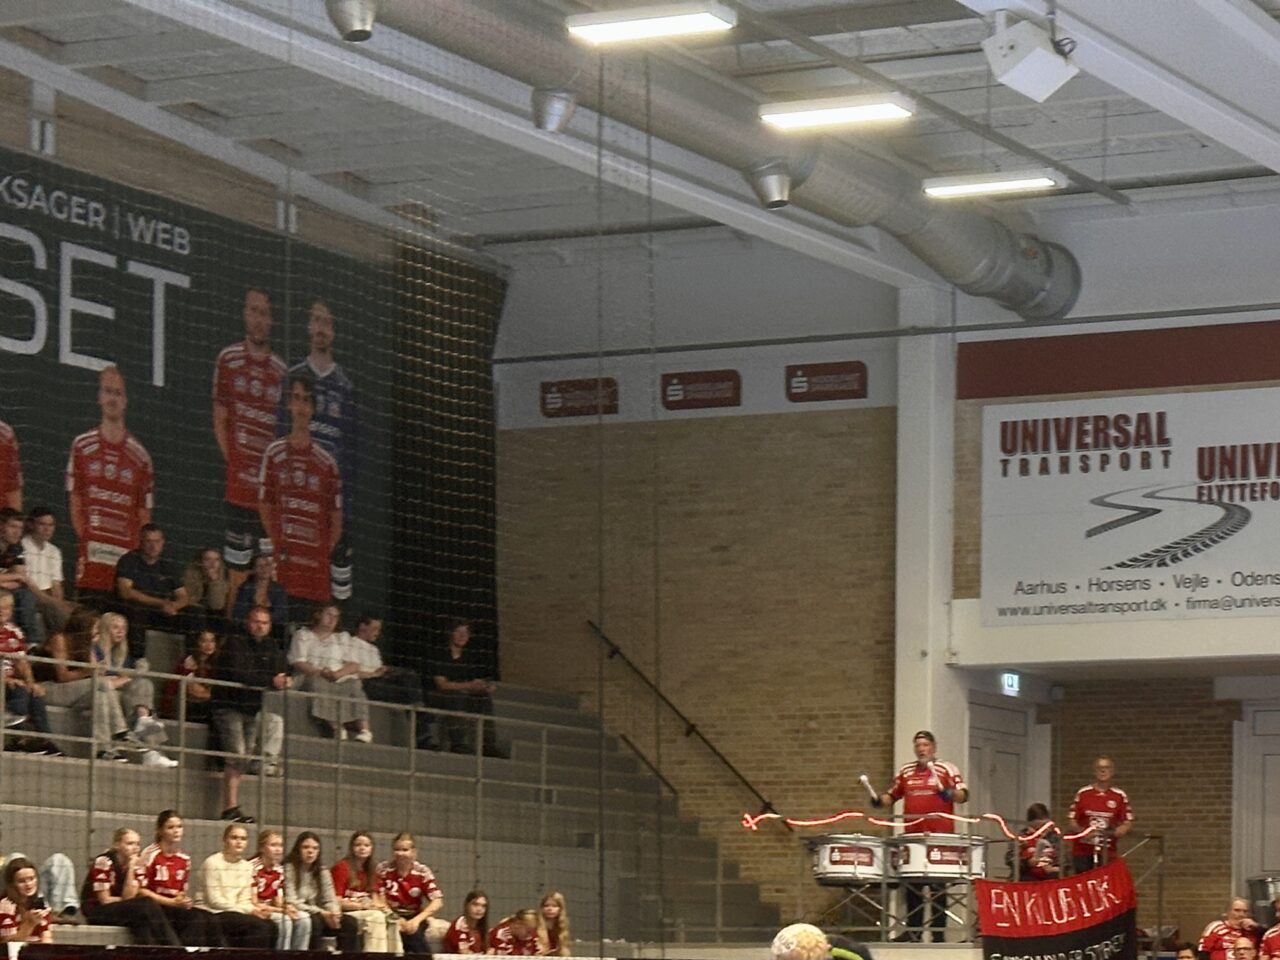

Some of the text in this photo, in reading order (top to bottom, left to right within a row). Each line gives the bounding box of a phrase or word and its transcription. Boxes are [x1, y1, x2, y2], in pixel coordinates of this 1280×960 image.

[129, 215, 191, 256] WEB
[1000, 411, 1171, 455] UNIVERSAL
[1000, 450, 1171, 477] TRANSPORT
[1014, 579, 1067, 596] Aarhus
[1088, 576, 1151, 593] Horsens
[1172, 573, 1209, 592] Vejle
[997, 599, 1167, 617] www.universaltransport.dk
